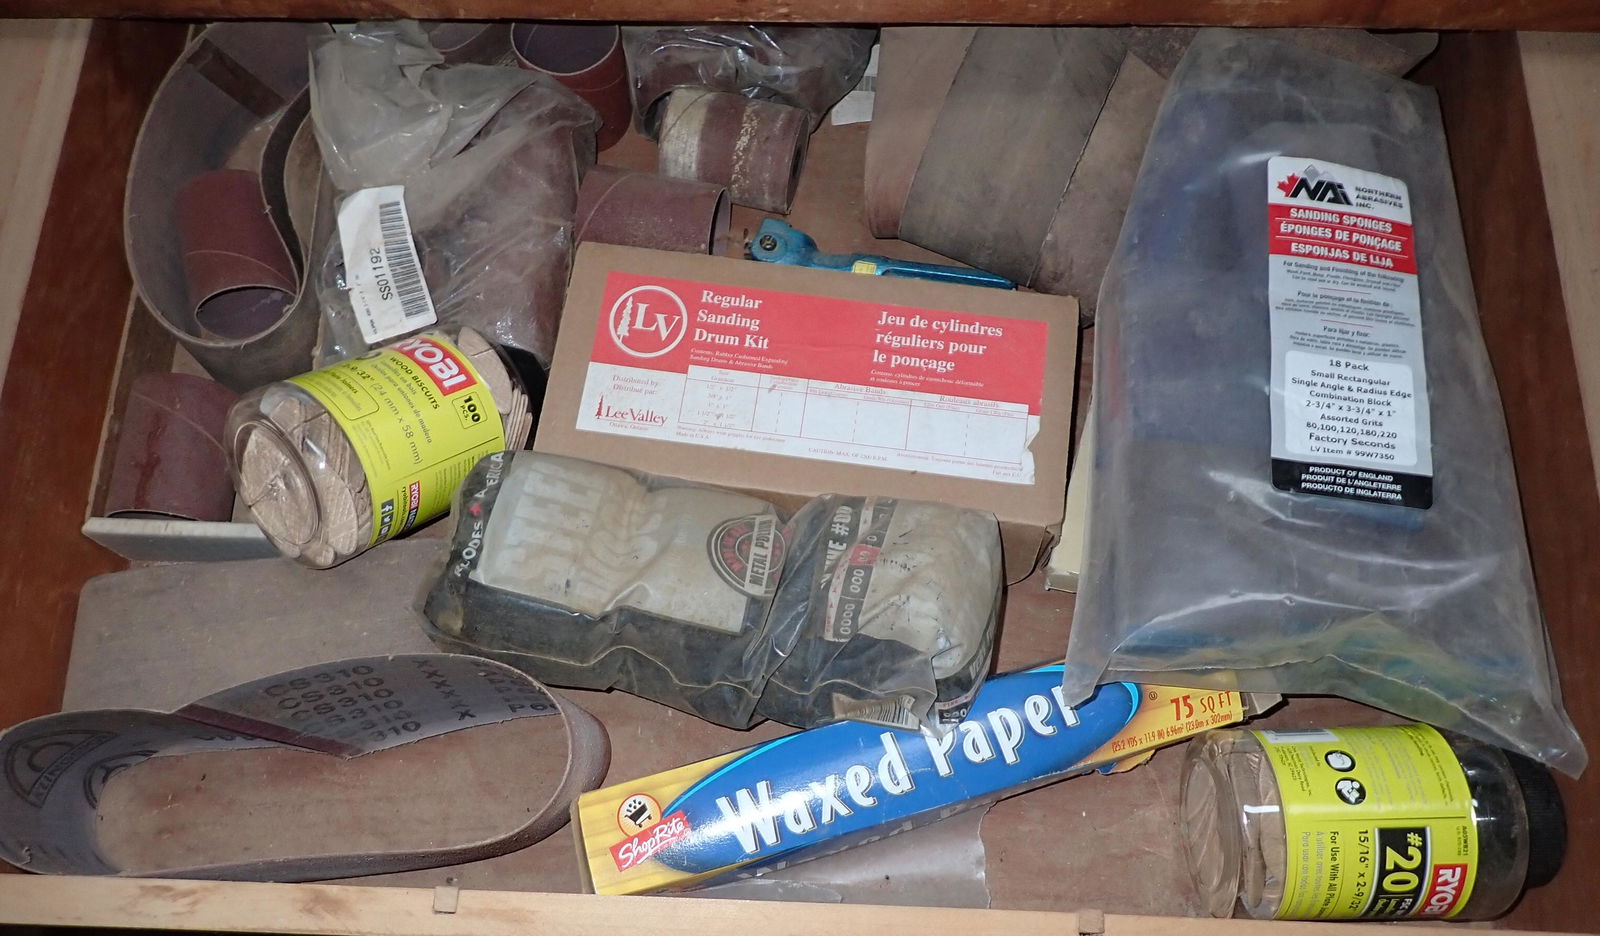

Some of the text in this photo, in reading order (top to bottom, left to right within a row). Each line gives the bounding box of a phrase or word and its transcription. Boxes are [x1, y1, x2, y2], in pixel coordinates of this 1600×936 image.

[1355, 186, 1402, 200] NORTHERN
[1356, 194, 1403, 209] ABRASIVES
[1356, 201, 1375, 210] INC.
[1290, 208, 1392, 233] SANDING SPONGES
[1280, 220, 1402, 251] ÉPONGES DE PONÇAGE
[1291, 242, 1394, 268] ESPONJAS DE LIJA
[370, 247, 393, 301] SS01192
[1294, 261, 1318, 272] Sanding
[702, 289, 763, 309] Regular
[633, 302, 681, 342] LV
[697, 309, 760, 331] Sanding
[877, 311, 1003, 337] Jeu de cylindres
[694, 328, 769, 349] Drum Kit
[876, 331, 987, 355] réguliers pour
[873, 350, 955, 373] le ponçage
[1329, 359, 1370, 371] 18 Pack
[391, 357, 440, 410] WOOD BISCUITS
[612, 375, 648, 386] Distributed
[1292, 377, 1318, 388] Single
[1320, 380, 1345, 391] Angle
[1356, 387, 1388, 396] Radius
[1390, 389, 1412, 399] Edge
[1311, 369, 1391, 386] Small Rectangular
[464, 395, 481, 422] 100
[1306, 400, 1335, 410] 2-3/4"
[1346, 406, 1375, 415] 3-3/4"
[1310, 390, 1392, 407] Combination Block
[369, 382, 387, 397] (24
[385, 398, 400, 416] mm
[402, 424, 414, 439] 58
[409, 441, 423, 465] mm)
[460, 405, 470, 421] PCS.
[605, 405, 668, 426] Lee Valley
[1320, 413, 1383, 427] Assorted Grits
[1306, 422, 1398, 440] 80,100,120,180,220
[1309, 433, 1396, 450] Factory Seconds
[1323, 447, 1343, 455] Item
[1355, 450, 1395, 461] 99W7350
[475, 452, 504, 498] AERICA
[1301, 473, 1402, 491] PRODUIT DE L'ANGLETERRE
[1309, 466, 1393, 482] PRODUCT OF ENGLAND
[1301, 482, 1402, 501] PRODUCTO DE INGLATERRA
[749, 552, 768, 586] METAL
[840, 603, 855, 635] 0000
[850, 569, 865, 593] 000
[264, 665, 374, 697] CS310
[278, 677, 385, 710] CS310
[1170, 690, 1232, 721] 75 SQ FT
[1144, 732, 1156, 743] 11.9
[715, 685, 1080, 854] Waxed Paper
[618, 817, 685, 868] ShopRite
[1329, 831, 1339, 844] For
[1331, 847, 1340, 862] Use
[1358, 829, 1369, 869] 15/16"
[1329, 863, 1340, 881] With
[1383, 831, 1423, 892] #20
[1327, 882, 1338, 892] All
[1425, 866, 1462, 915] RYOB
